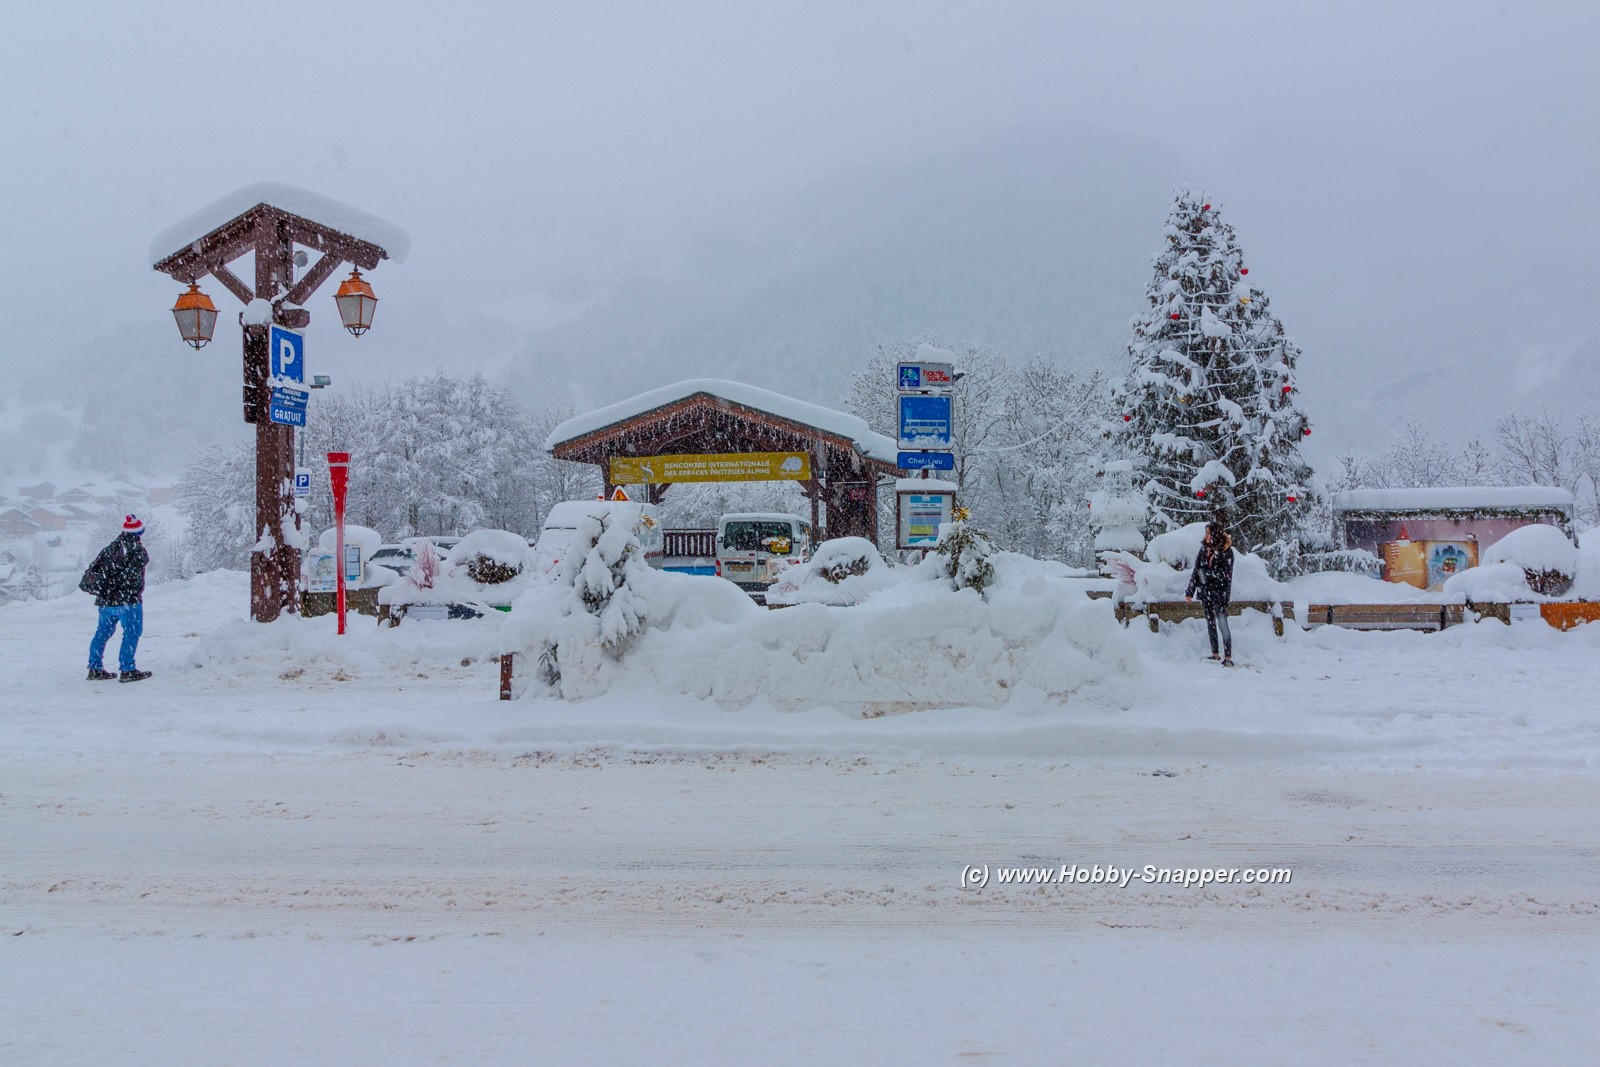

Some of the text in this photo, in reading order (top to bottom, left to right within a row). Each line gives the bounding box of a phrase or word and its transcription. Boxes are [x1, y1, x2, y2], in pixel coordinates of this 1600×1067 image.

[280, 338, 295, 373] P
[274, 409, 302, 422] GRATUIT
[708, 460, 770, 468] INTERNATIONALE
[908, 457, 943, 465] Chef-Lieu
[299, 475, 307, 486] P
